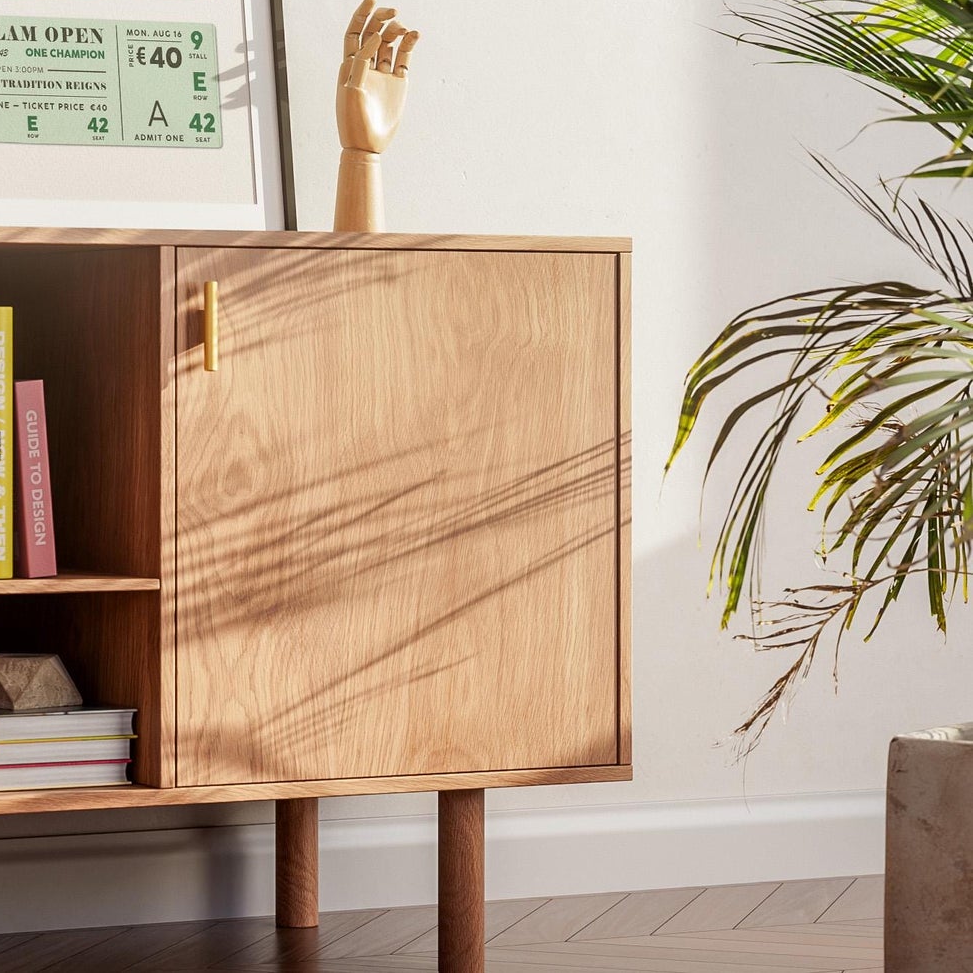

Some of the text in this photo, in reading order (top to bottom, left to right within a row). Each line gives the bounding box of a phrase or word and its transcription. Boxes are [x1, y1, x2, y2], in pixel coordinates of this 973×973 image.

[45, 26, 104, 44] OPEN
[127, 29, 182, 38] MON. AUG 16
[190, 30, 203, 50] 9
[25, 48, 105, 60] ONE CHAMPION
[127, 43, 135, 68] PRICE
[136, 46, 183, 69] €40
[15, 66, 44, 74] 3:00PM
[0, 79, 62, 90] TRADITION
[65, 81, 107, 91] REIGNS
[193, 71, 207, 92] E
[22, 102, 55, 111] TICKET
[58, 103, 85, 111] PRICE
[90, 103, 108, 112] €40
[148, 100, 169, 127] A
[27, 115, 39, 132] E
[87, 117, 109, 133] 42
[189, 113, 216, 133] 42
[134, 134, 185, 142] ADMIT ONE
[26, 409, 47, 546] GUIDE TO DESIGN
